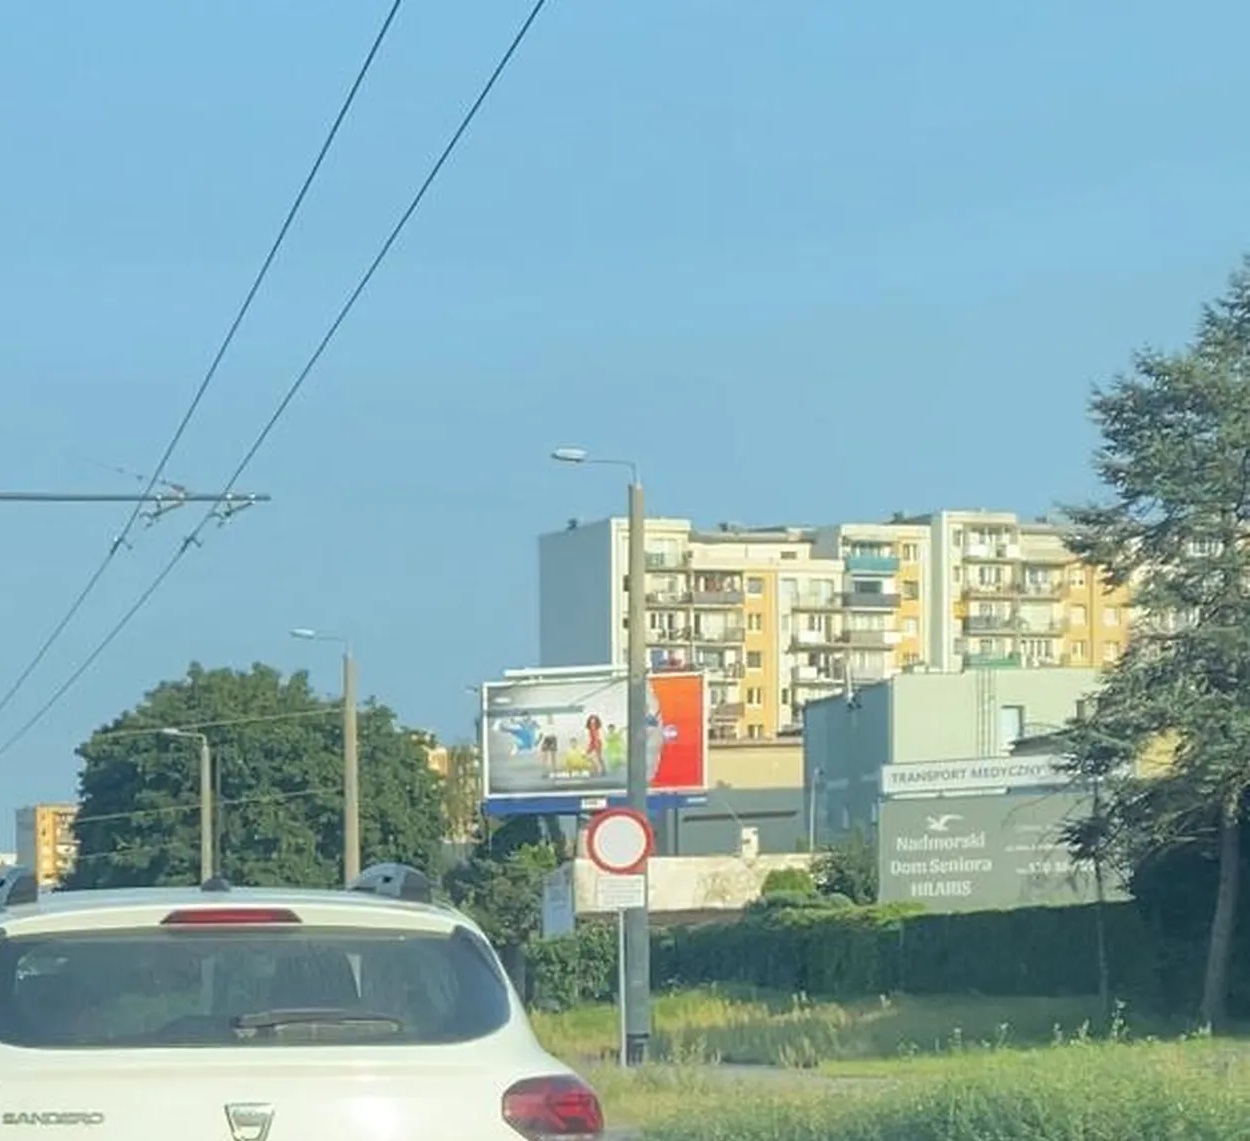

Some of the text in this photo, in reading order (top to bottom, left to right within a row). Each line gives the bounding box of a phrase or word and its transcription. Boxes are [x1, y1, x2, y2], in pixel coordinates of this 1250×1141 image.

[891, 767, 966, 784] TRANSPORT
[896, 832, 985, 851] Nadmorski
[890, 858, 993, 876] Dom Seniora
[2, 1112, 105, 1125] SANDERO
